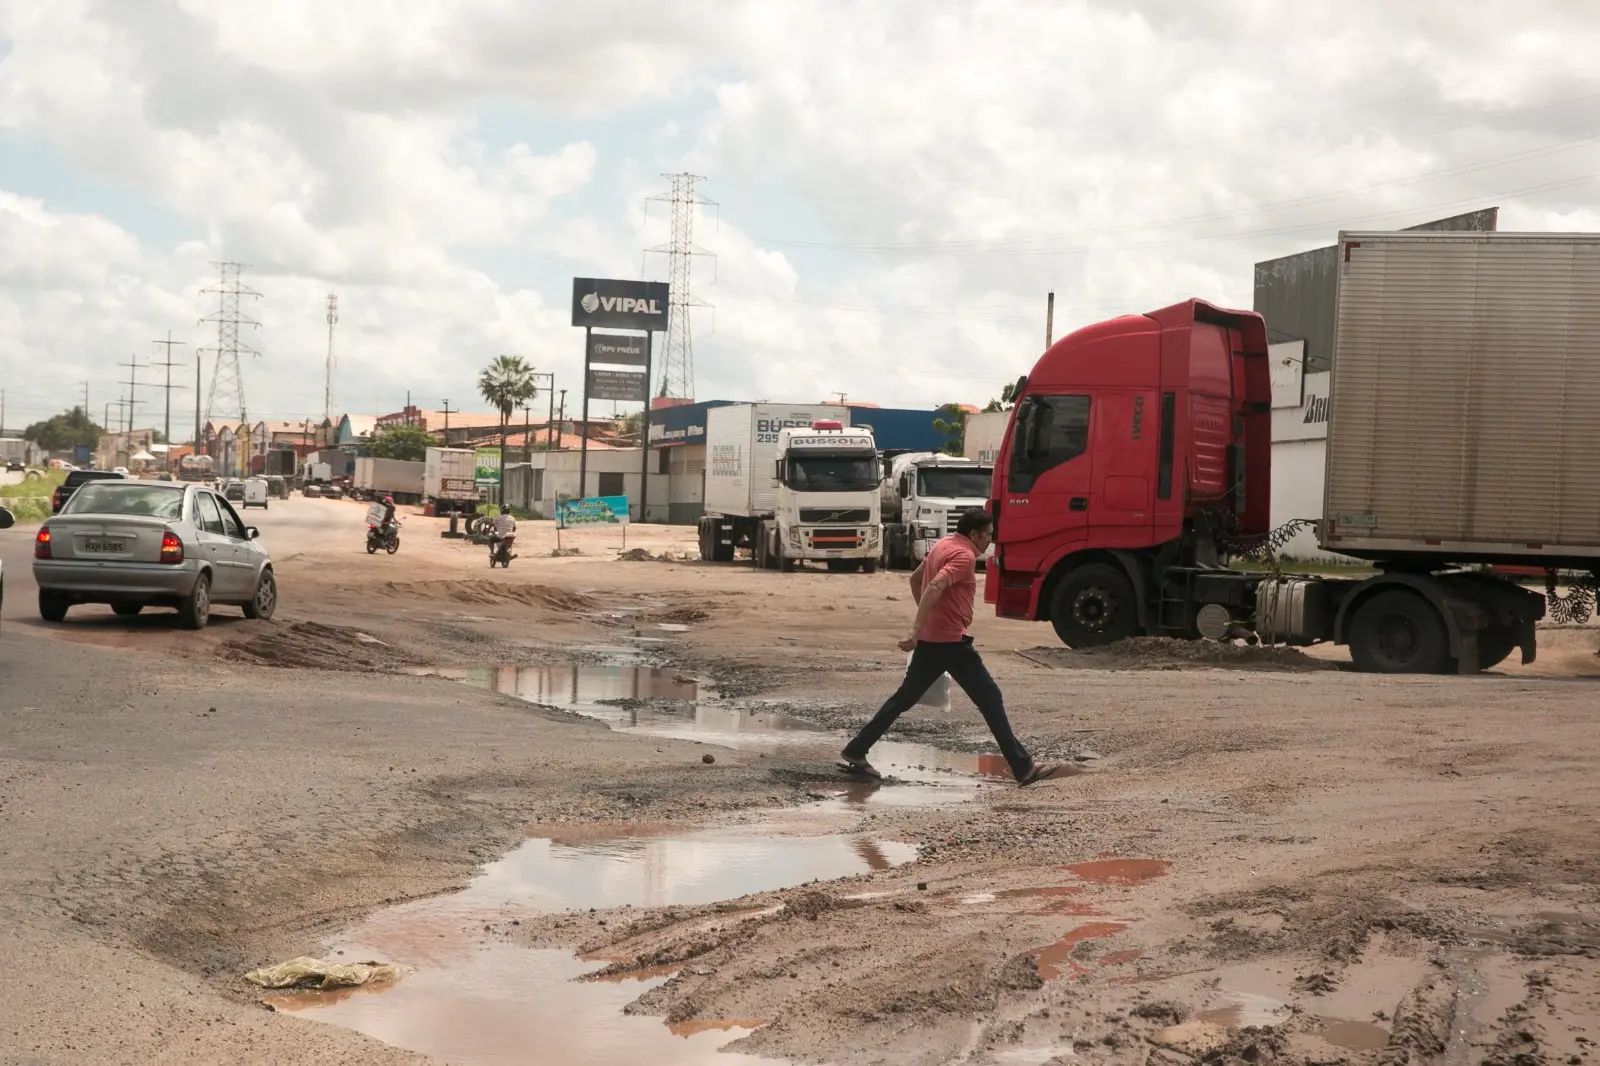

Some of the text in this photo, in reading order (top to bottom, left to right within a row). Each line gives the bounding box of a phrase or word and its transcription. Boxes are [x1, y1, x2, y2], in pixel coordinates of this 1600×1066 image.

[600, 296, 662, 314] VIPAL
[616, 346, 640, 354] PNEUS
[1131, 395, 1144, 440] IVECO
[1303, 394, 1330, 424] BRI
